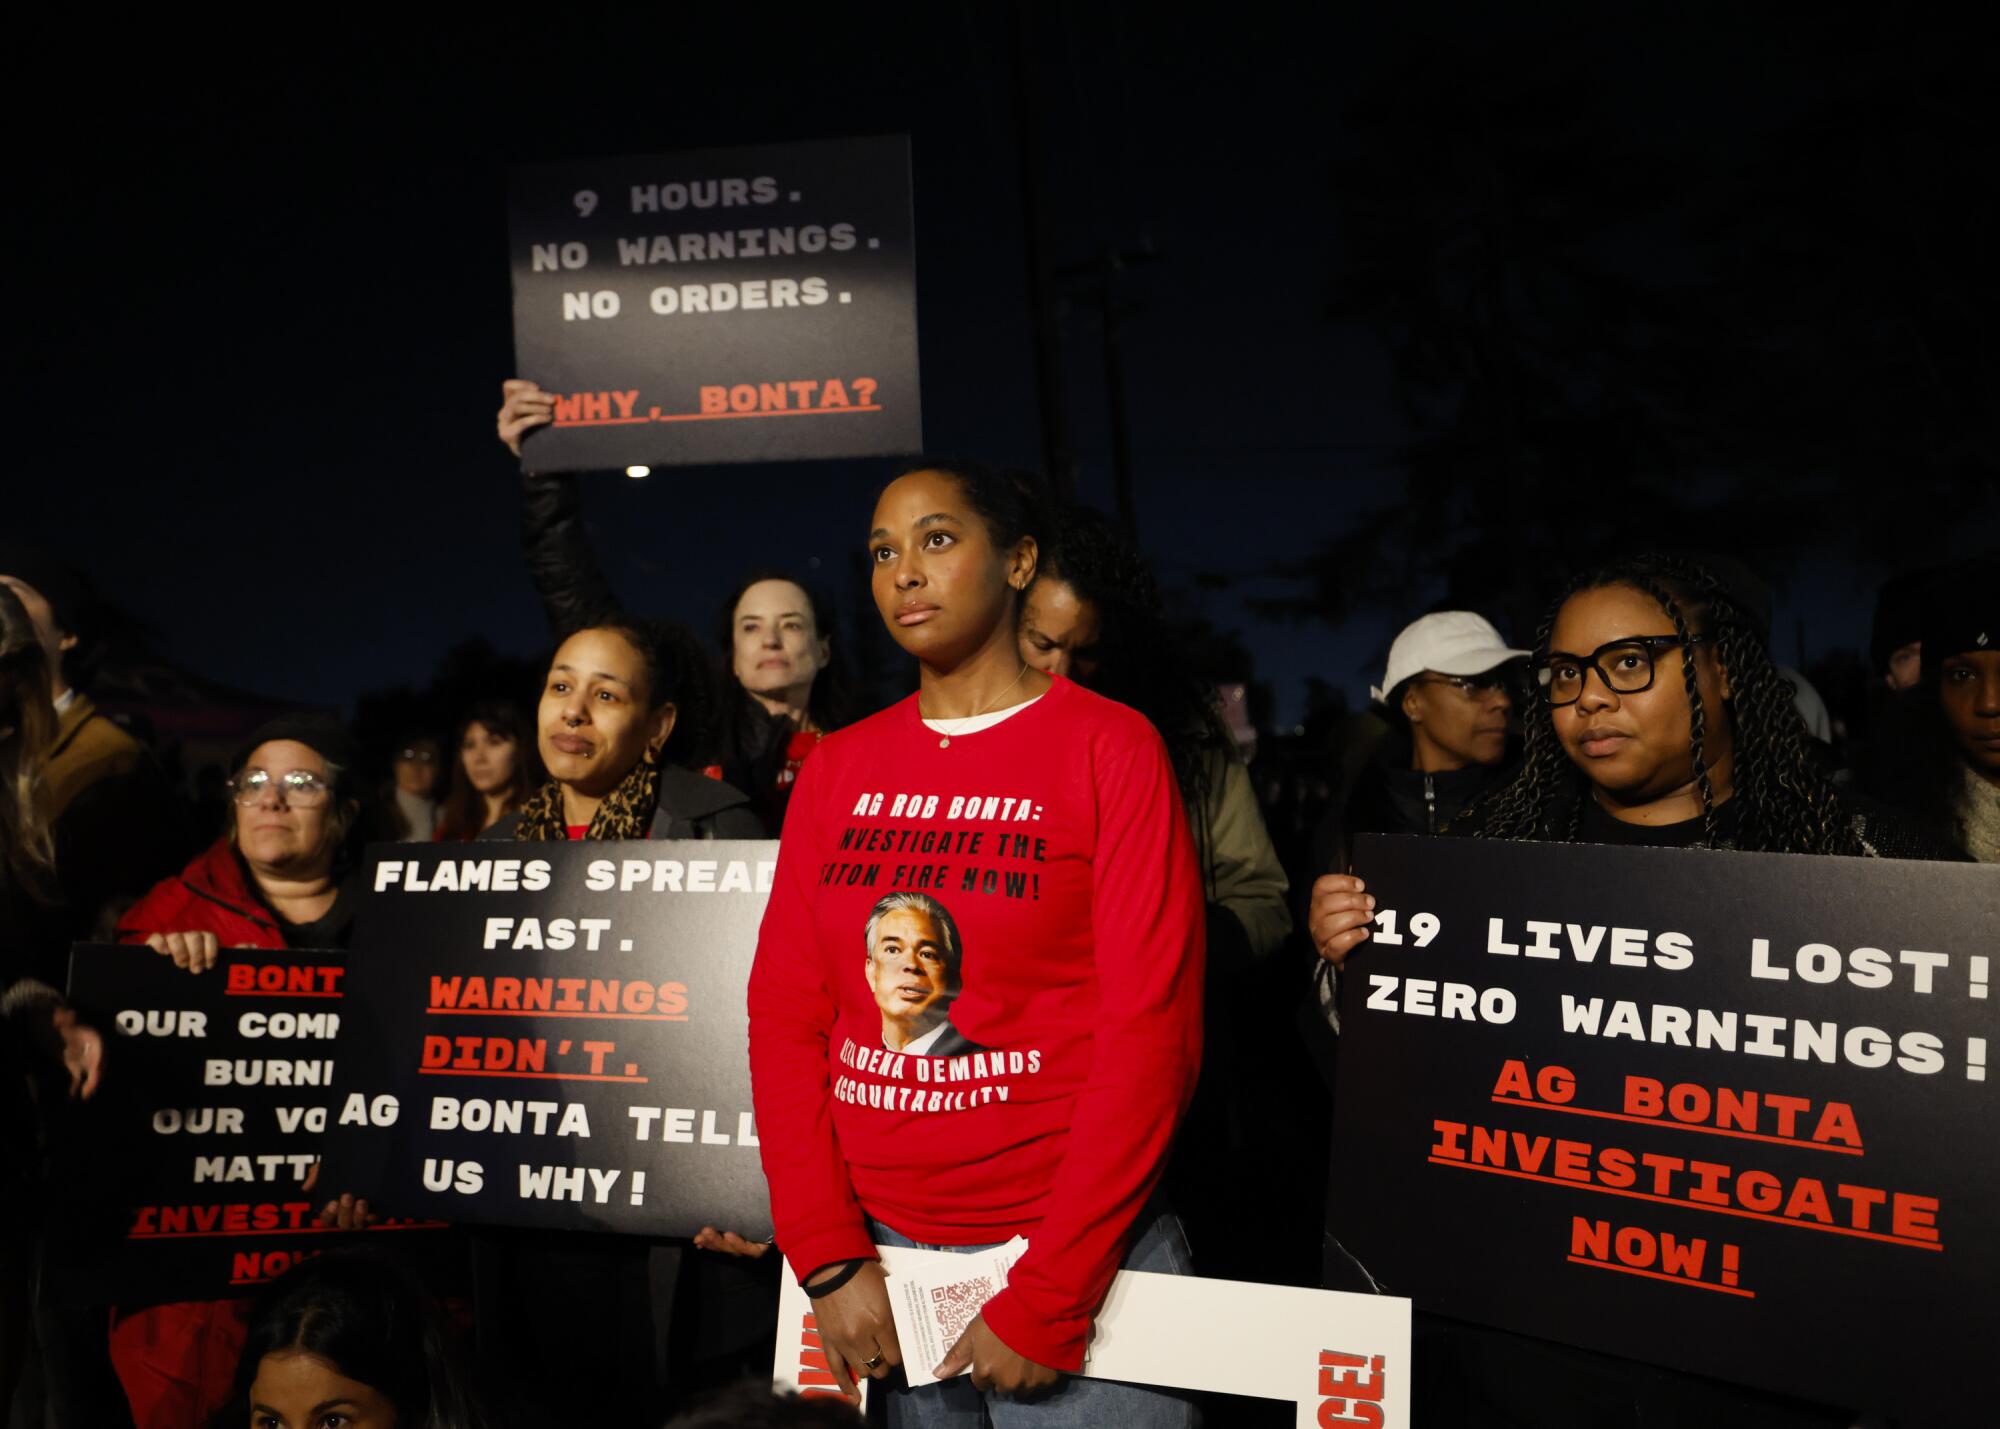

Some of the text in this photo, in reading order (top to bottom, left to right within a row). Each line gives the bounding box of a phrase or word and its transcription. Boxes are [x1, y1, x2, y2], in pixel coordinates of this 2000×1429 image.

[573, 176, 801, 217] 9 HOURS.
[532, 223, 880, 272] NO WARNINGS.
[563, 277, 852, 321] NO ORDERS.
[554, 378, 877, 421] WHY, BONTA?
[853, 792, 1043, 822] AG ROB BONTA:
[841, 828, 1047, 863] NVESTIGATE THE
[374, 859, 777, 892] FLAMES SPREAD
[820, 863, 1040, 901] ATON FIRE NOW!
[483, 917, 633, 952] FAST.
[1372, 909, 1989, 998] 19 LIVES LOST!
[429, 975, 689, 1015] WARNINGS
[115, 1010, 208, 1038] OUR
[1366, 974, 1987, 1081] ZERO WARNINGS!
[916, 1050, 1042, 1083] DEMANDS
[153, 1108, 244, 1134] OUR
[338, 1093, 760, 1147] AG BONTA TELL
[1493, 1058, 1863, 1147] AG BONTA
[194, 1154, 321, 1183] MATT
[423, 1158, 646, 1206] US WHY!
[1431, 1119, 1941, 1241] INVESTIGATE
[1570, 1216, 1740, 1287] NOW!
